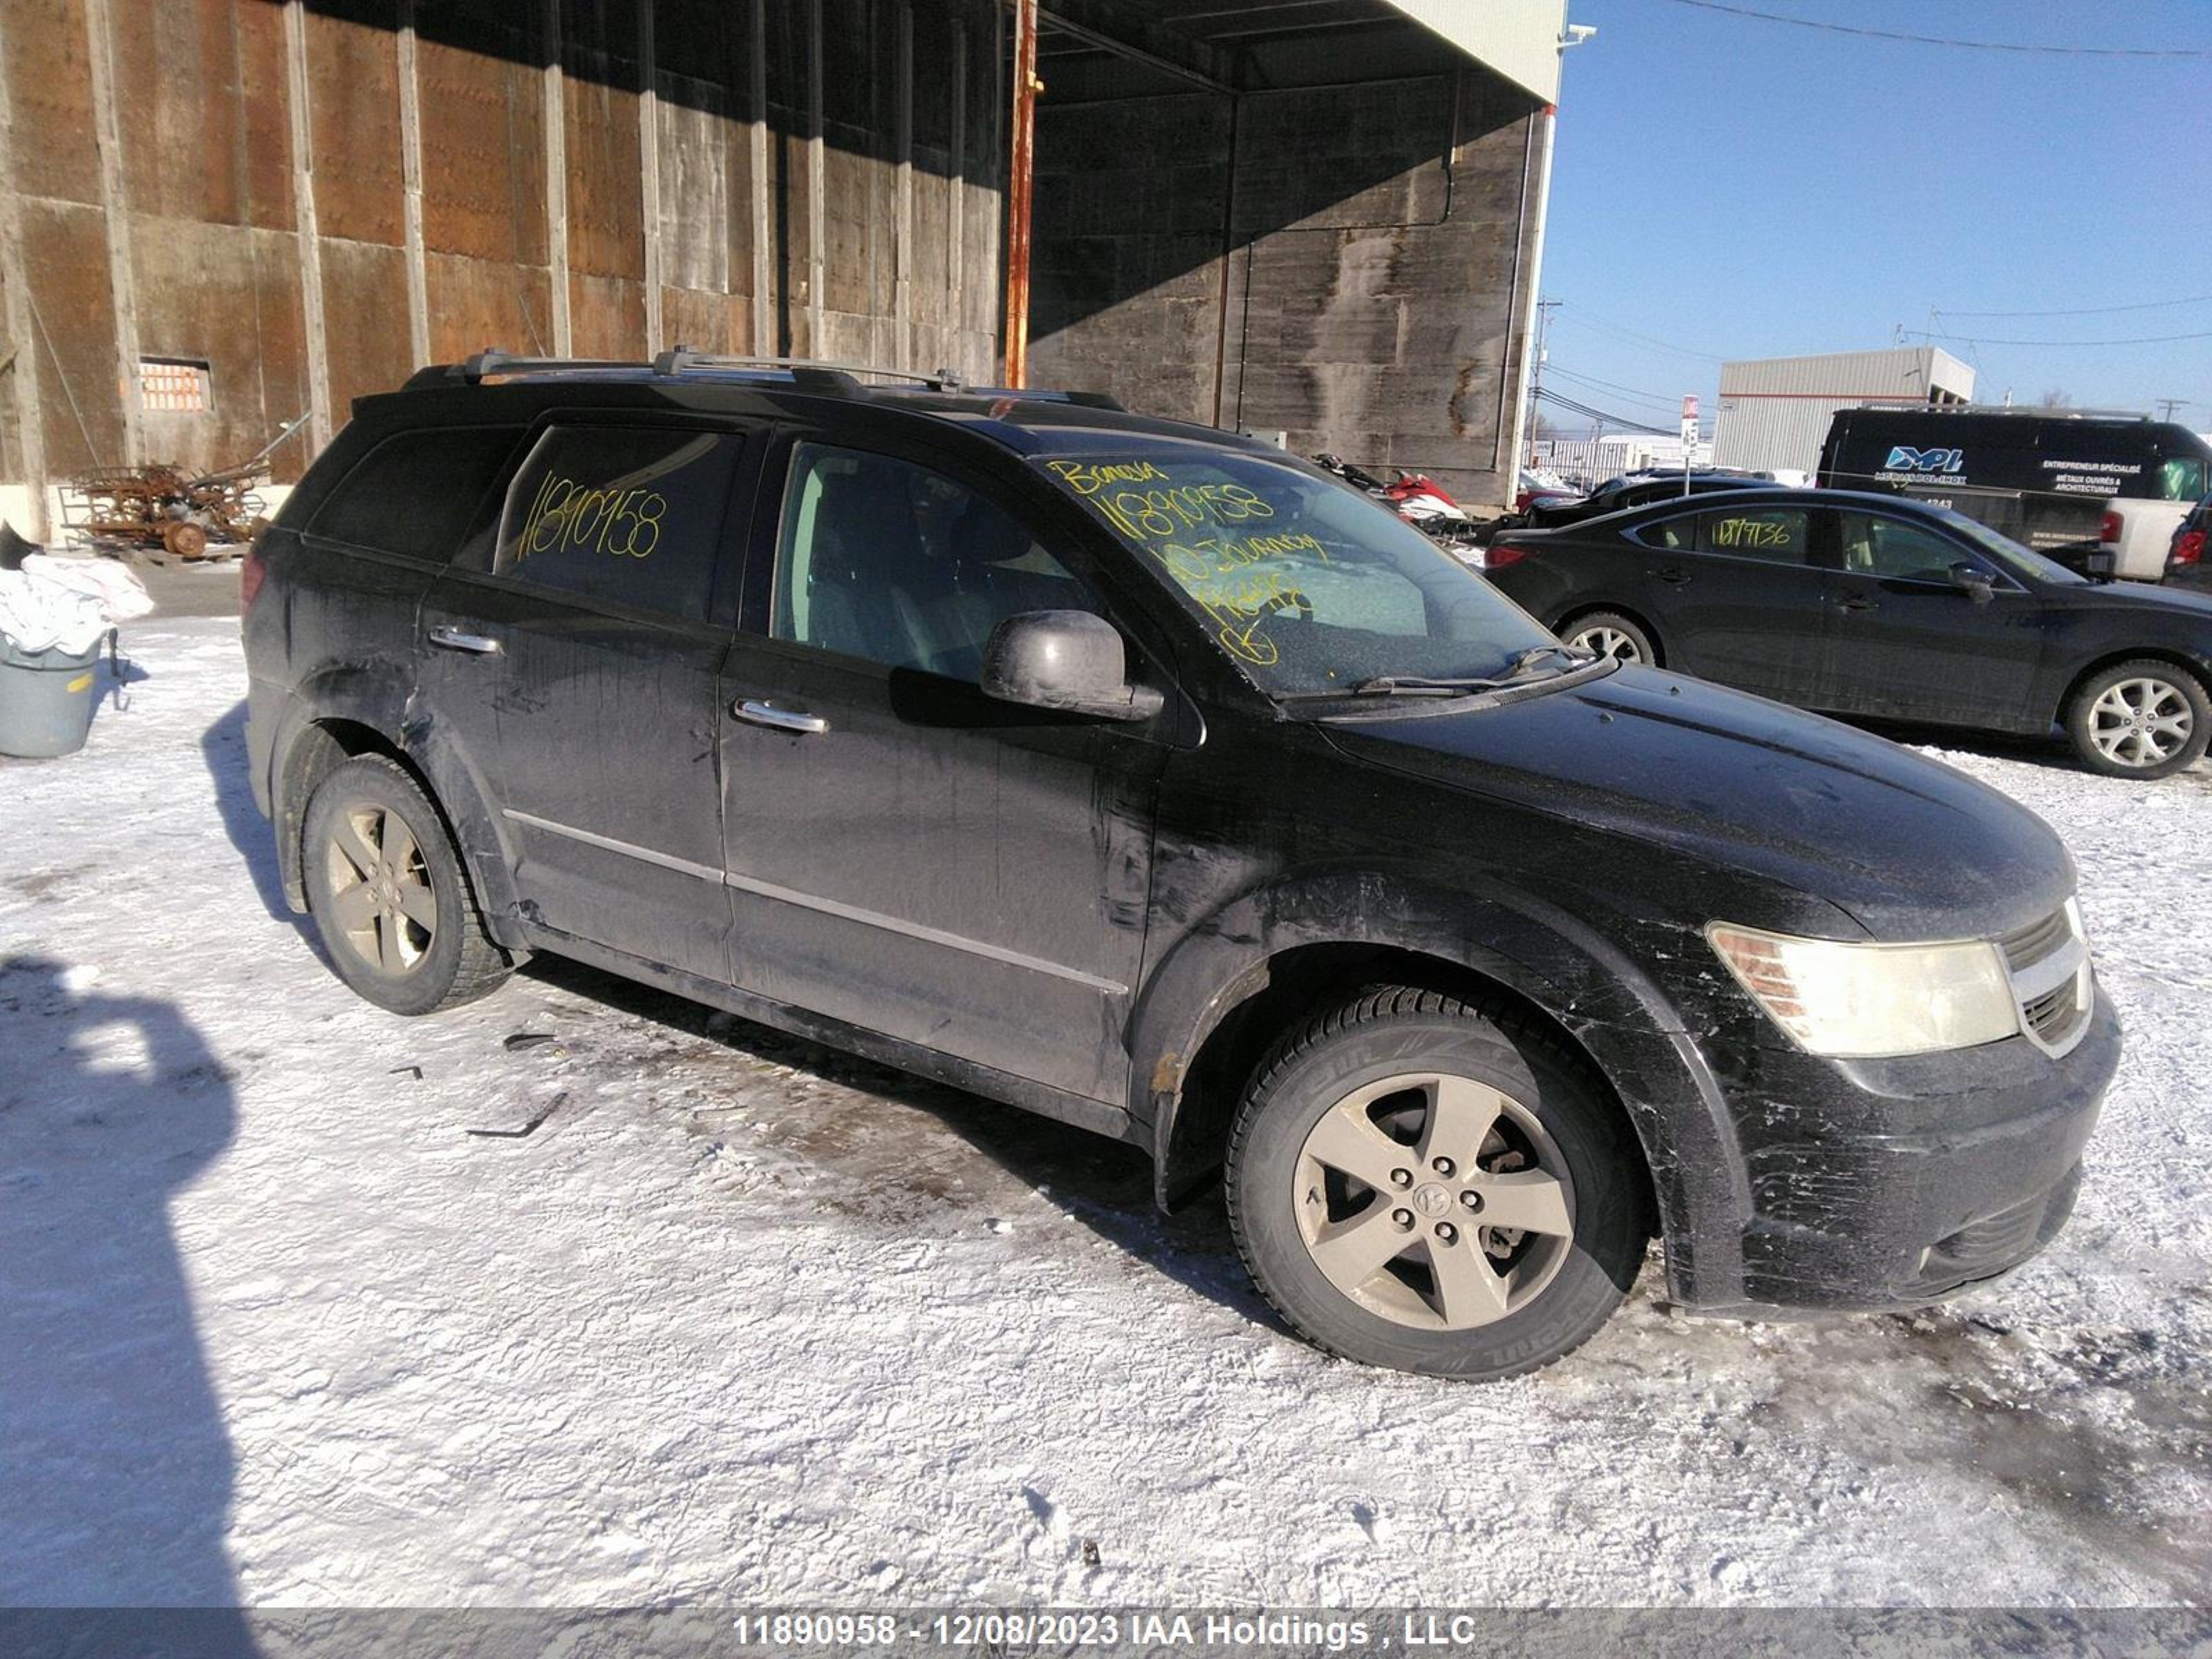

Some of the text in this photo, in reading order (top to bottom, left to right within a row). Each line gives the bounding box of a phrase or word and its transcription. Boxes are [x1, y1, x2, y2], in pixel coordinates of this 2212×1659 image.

[2043, 460, 2141, 474] ENTREPRENEUR SPÉCIALISÉ
[2056, 474, 2084, 482] MÉTAUX
[2086, 476, 2114, 485] OUVRÉS
[2055, 483, 2119, 494] ARCHITECTURAUX
[518, 470, 666, 563] 11890958
[1087, 485, 1274, 541] 11890958
